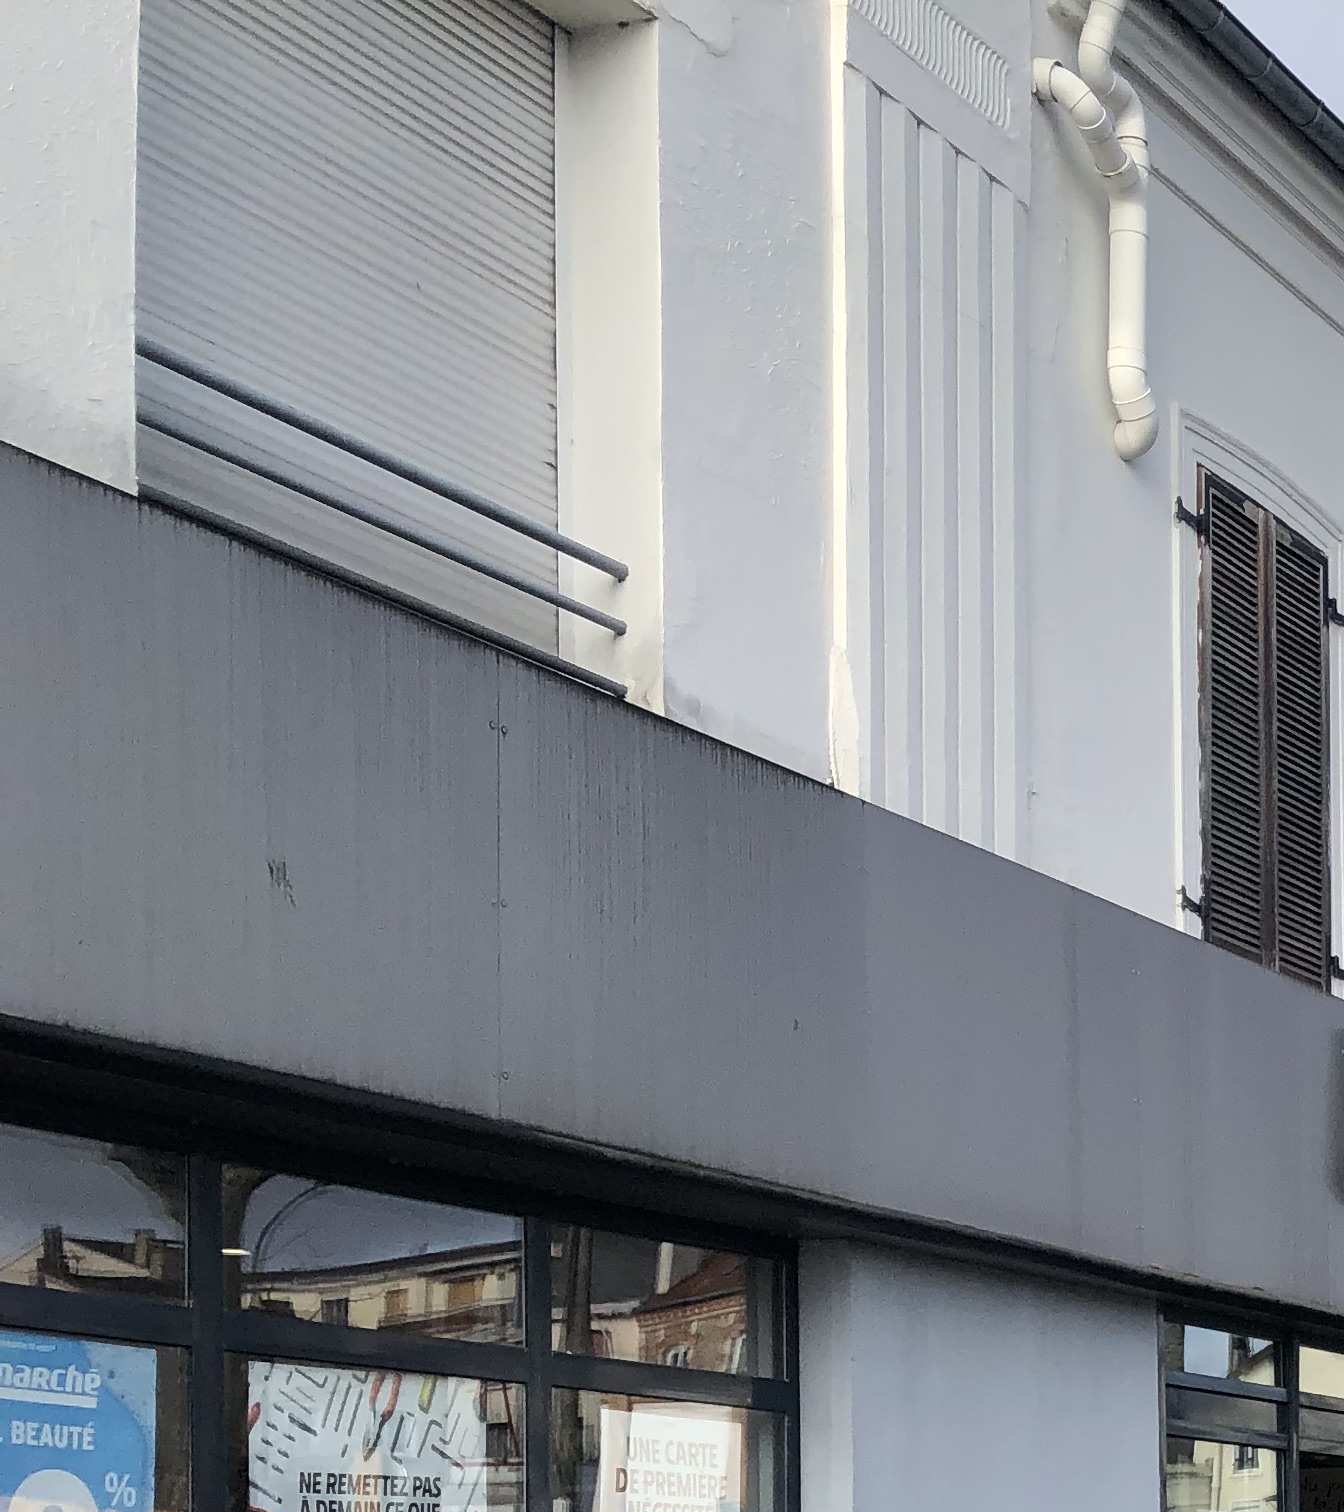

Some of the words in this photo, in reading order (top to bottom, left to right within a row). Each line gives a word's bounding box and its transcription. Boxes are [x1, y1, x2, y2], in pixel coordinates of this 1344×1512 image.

[11, 1420, 95, 1451] BEAUTÉ
[626, 1435, 660, 1464] UNE
[664, 1440, 719, 1468] CARTE
[299, 1471, 322, 1495] NE
[325, 1472, 409, 1497] REMETTEZ
[412, 1476, 442, 1499] PAS
[615, 1467, 640, 1494] DE
